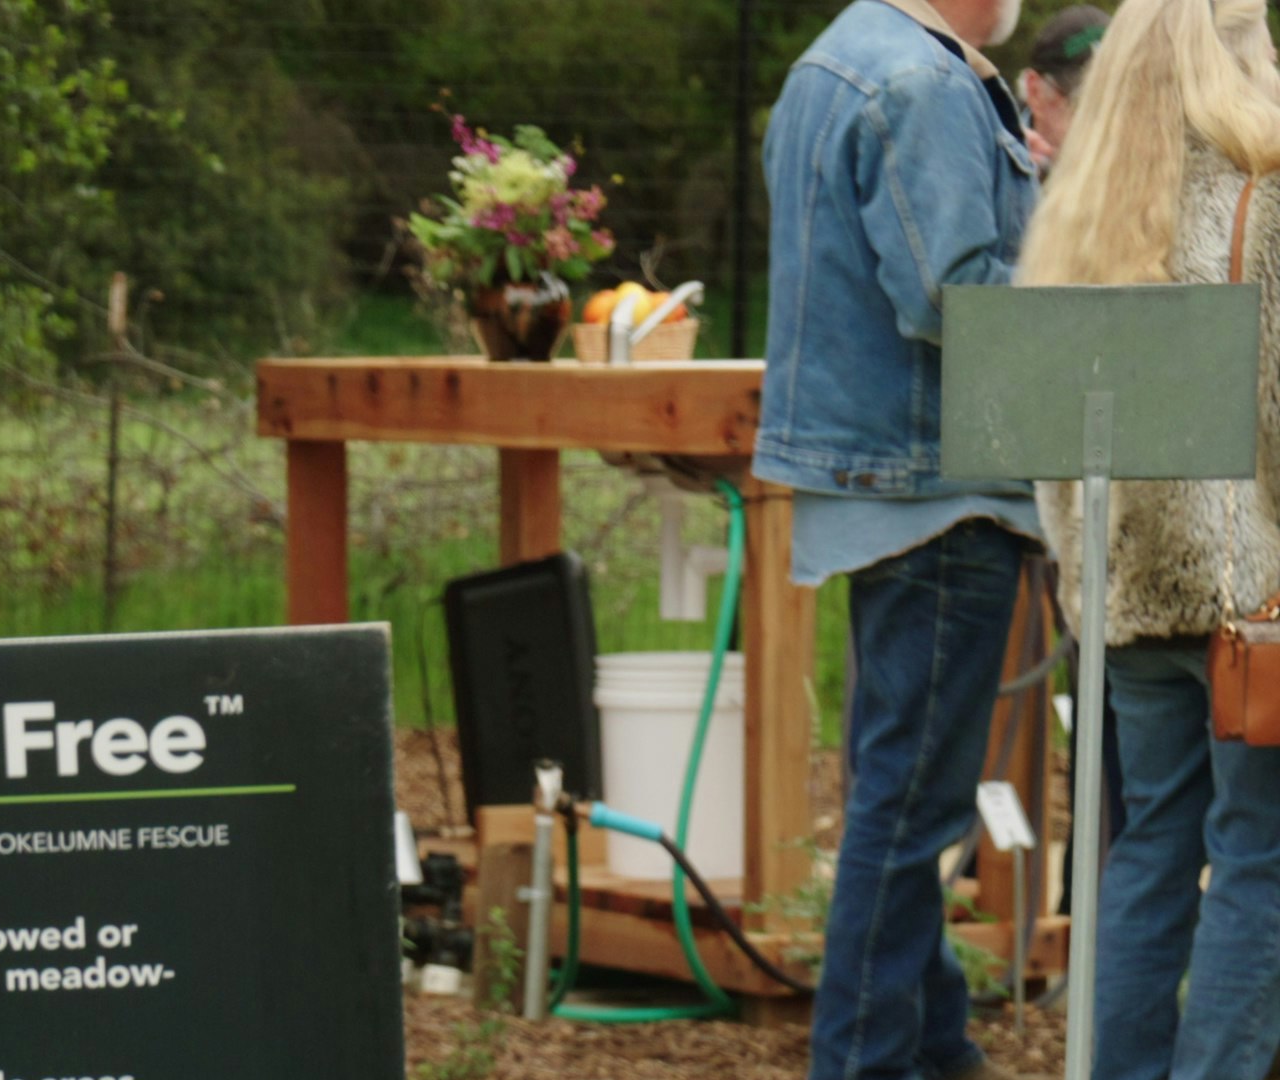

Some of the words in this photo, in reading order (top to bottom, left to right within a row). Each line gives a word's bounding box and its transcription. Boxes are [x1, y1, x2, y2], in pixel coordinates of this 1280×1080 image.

[137, 823, 230, 849] FESCUE
[97, 924, 138, 948] or
[5, 955, 175, 992] meadow-
